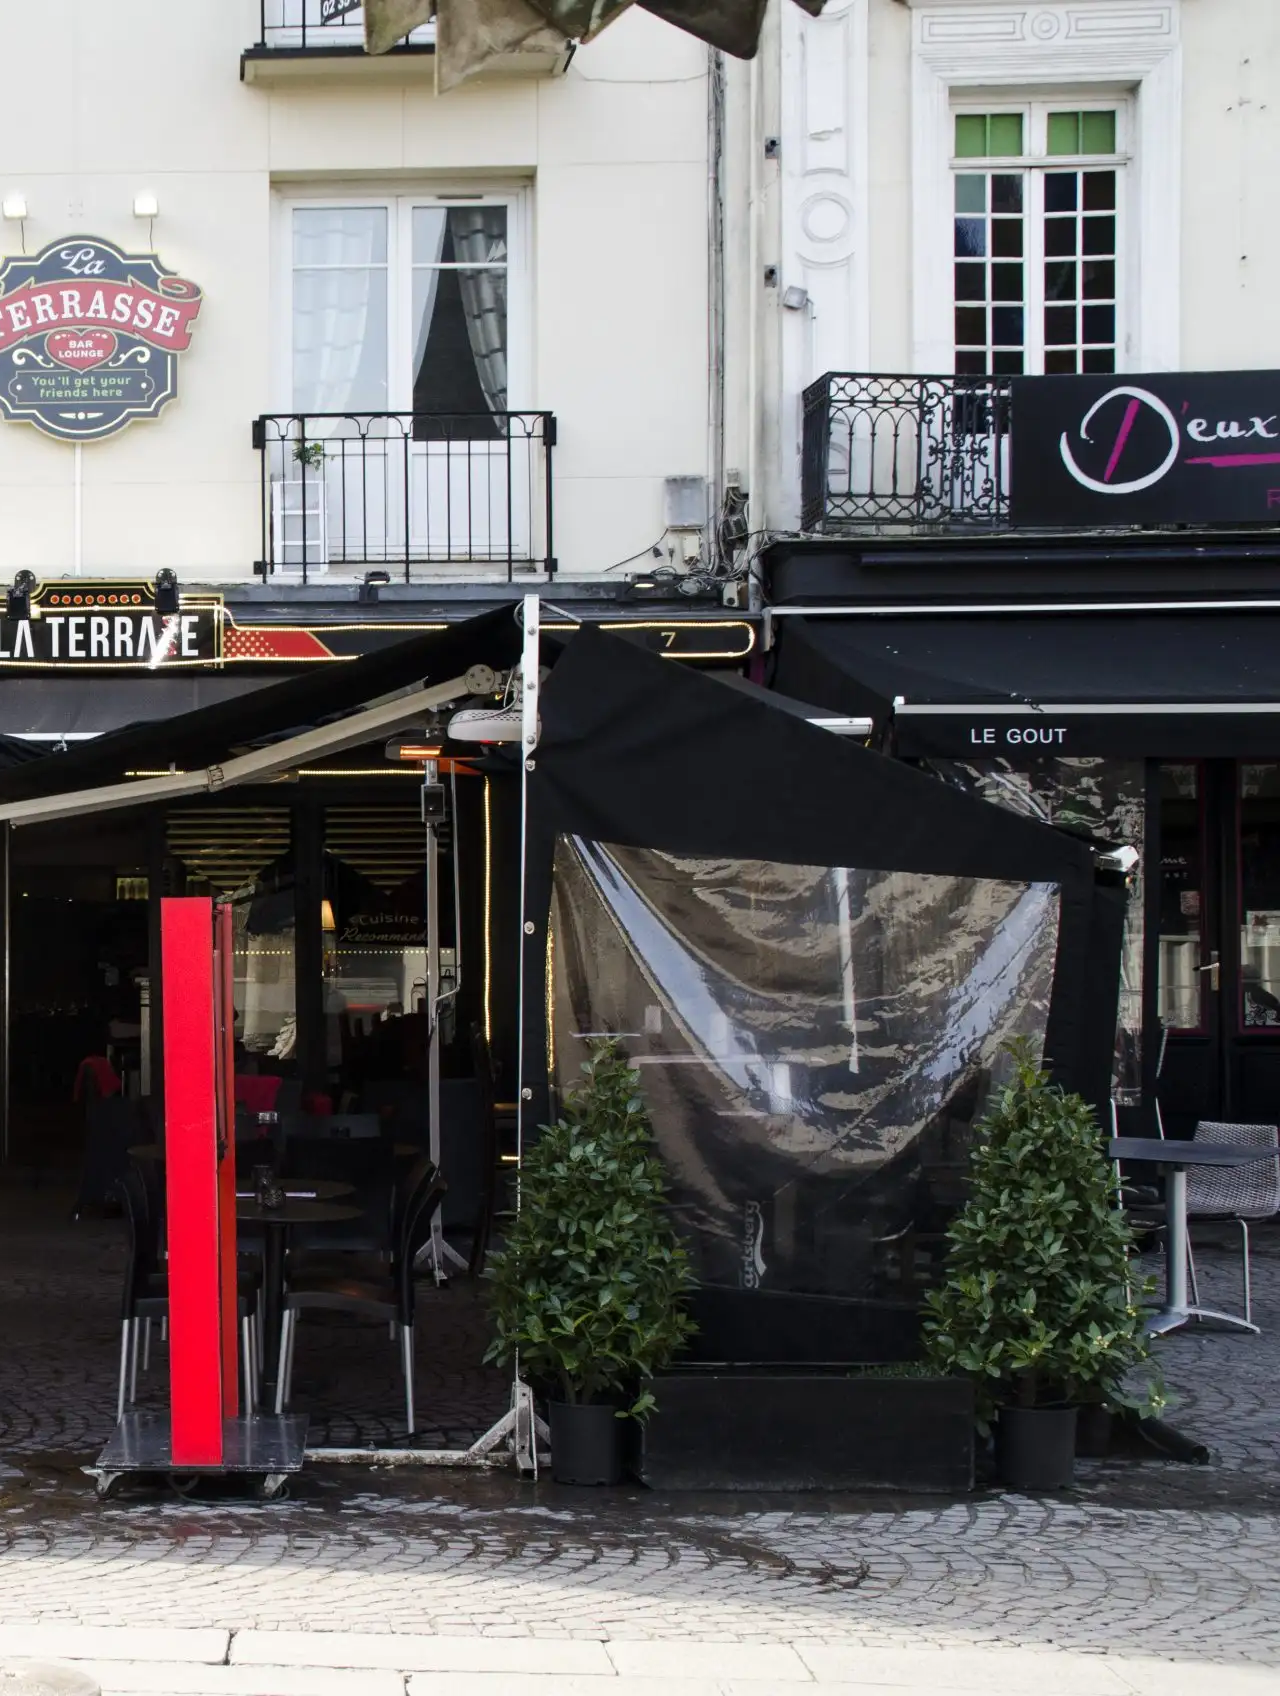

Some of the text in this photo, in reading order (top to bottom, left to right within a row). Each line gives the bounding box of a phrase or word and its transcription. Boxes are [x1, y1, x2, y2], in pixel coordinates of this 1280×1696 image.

[60, 248, 106, 275] La
[69, 340, 93, 348] BAR
[58, 350, 104, 358] LOUNGE
[74, 376, 95, 387] get
[100, 377, 131, 387] your
[40, 388, 122, 398] friends here
[660, 631, 676, 648] 7
[970, 728, 1067, 744] LE GOUT
